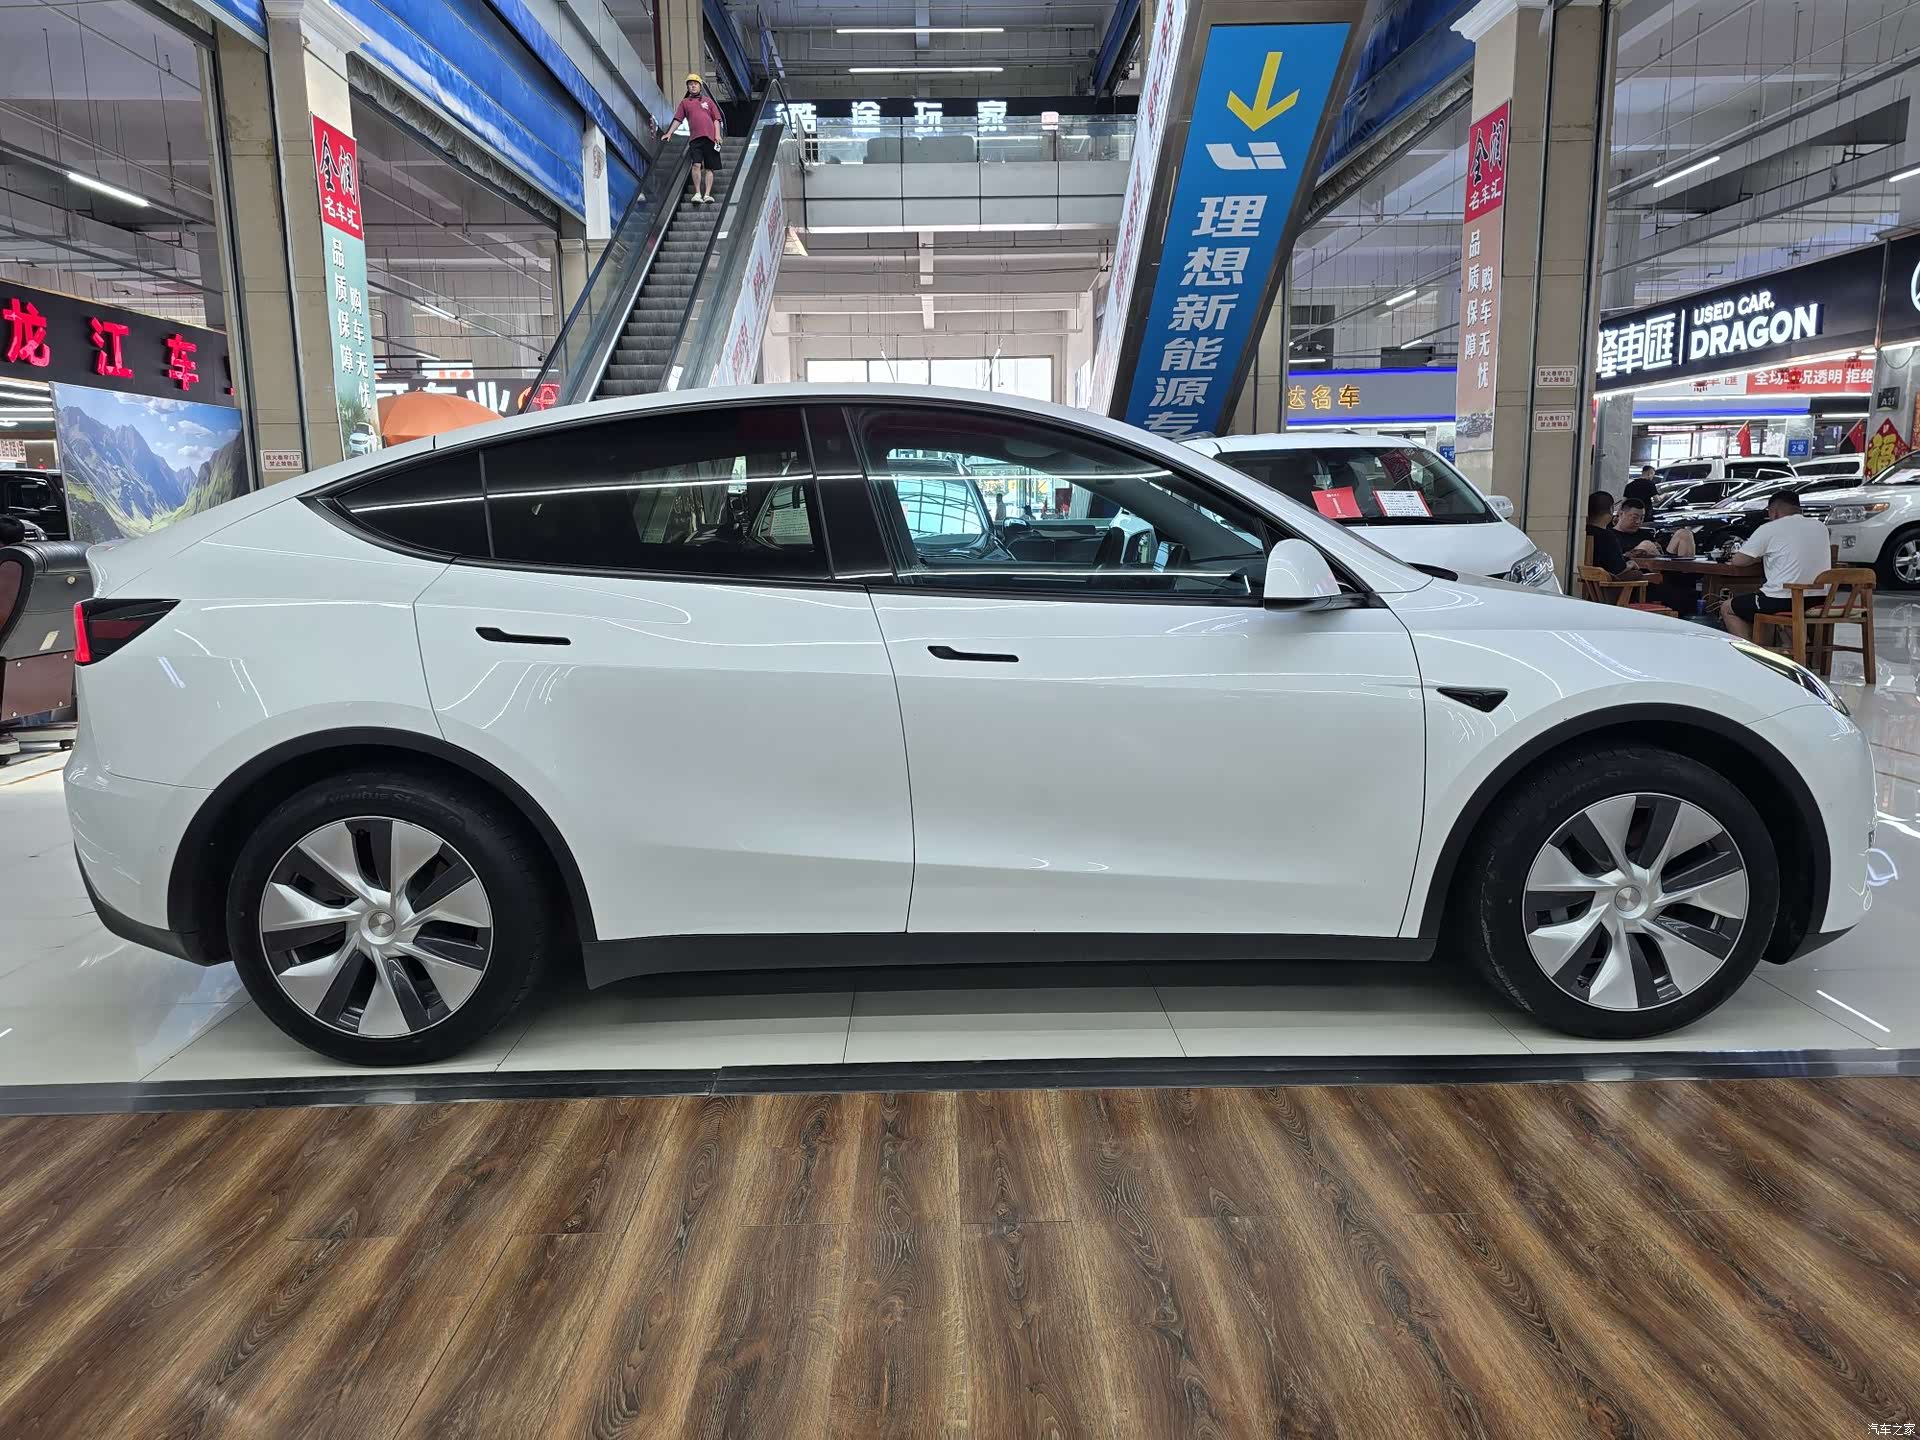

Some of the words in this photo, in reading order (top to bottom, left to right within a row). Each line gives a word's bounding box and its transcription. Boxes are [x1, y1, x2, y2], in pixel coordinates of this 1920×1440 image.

[324, 196, 360, 230] 名车汇
[1469, 177, 1501, 211] 名车汇
[332, 238, 354, 374] 品质保障
[1465, 228, 1481, 361] 品质保障
[1694, 301, 1734, 326] USED
[3, 298, 234, 396] 龙江车
[349, 287, 372, 410] 购车无忧
[1477, 265, 1494, 390] 购车无忧
[1689, 303, 1818, 360] DRAGON
[1754, 369, 1843, 385] 全场况透明
[1867, 433, 1897, 475] 福
